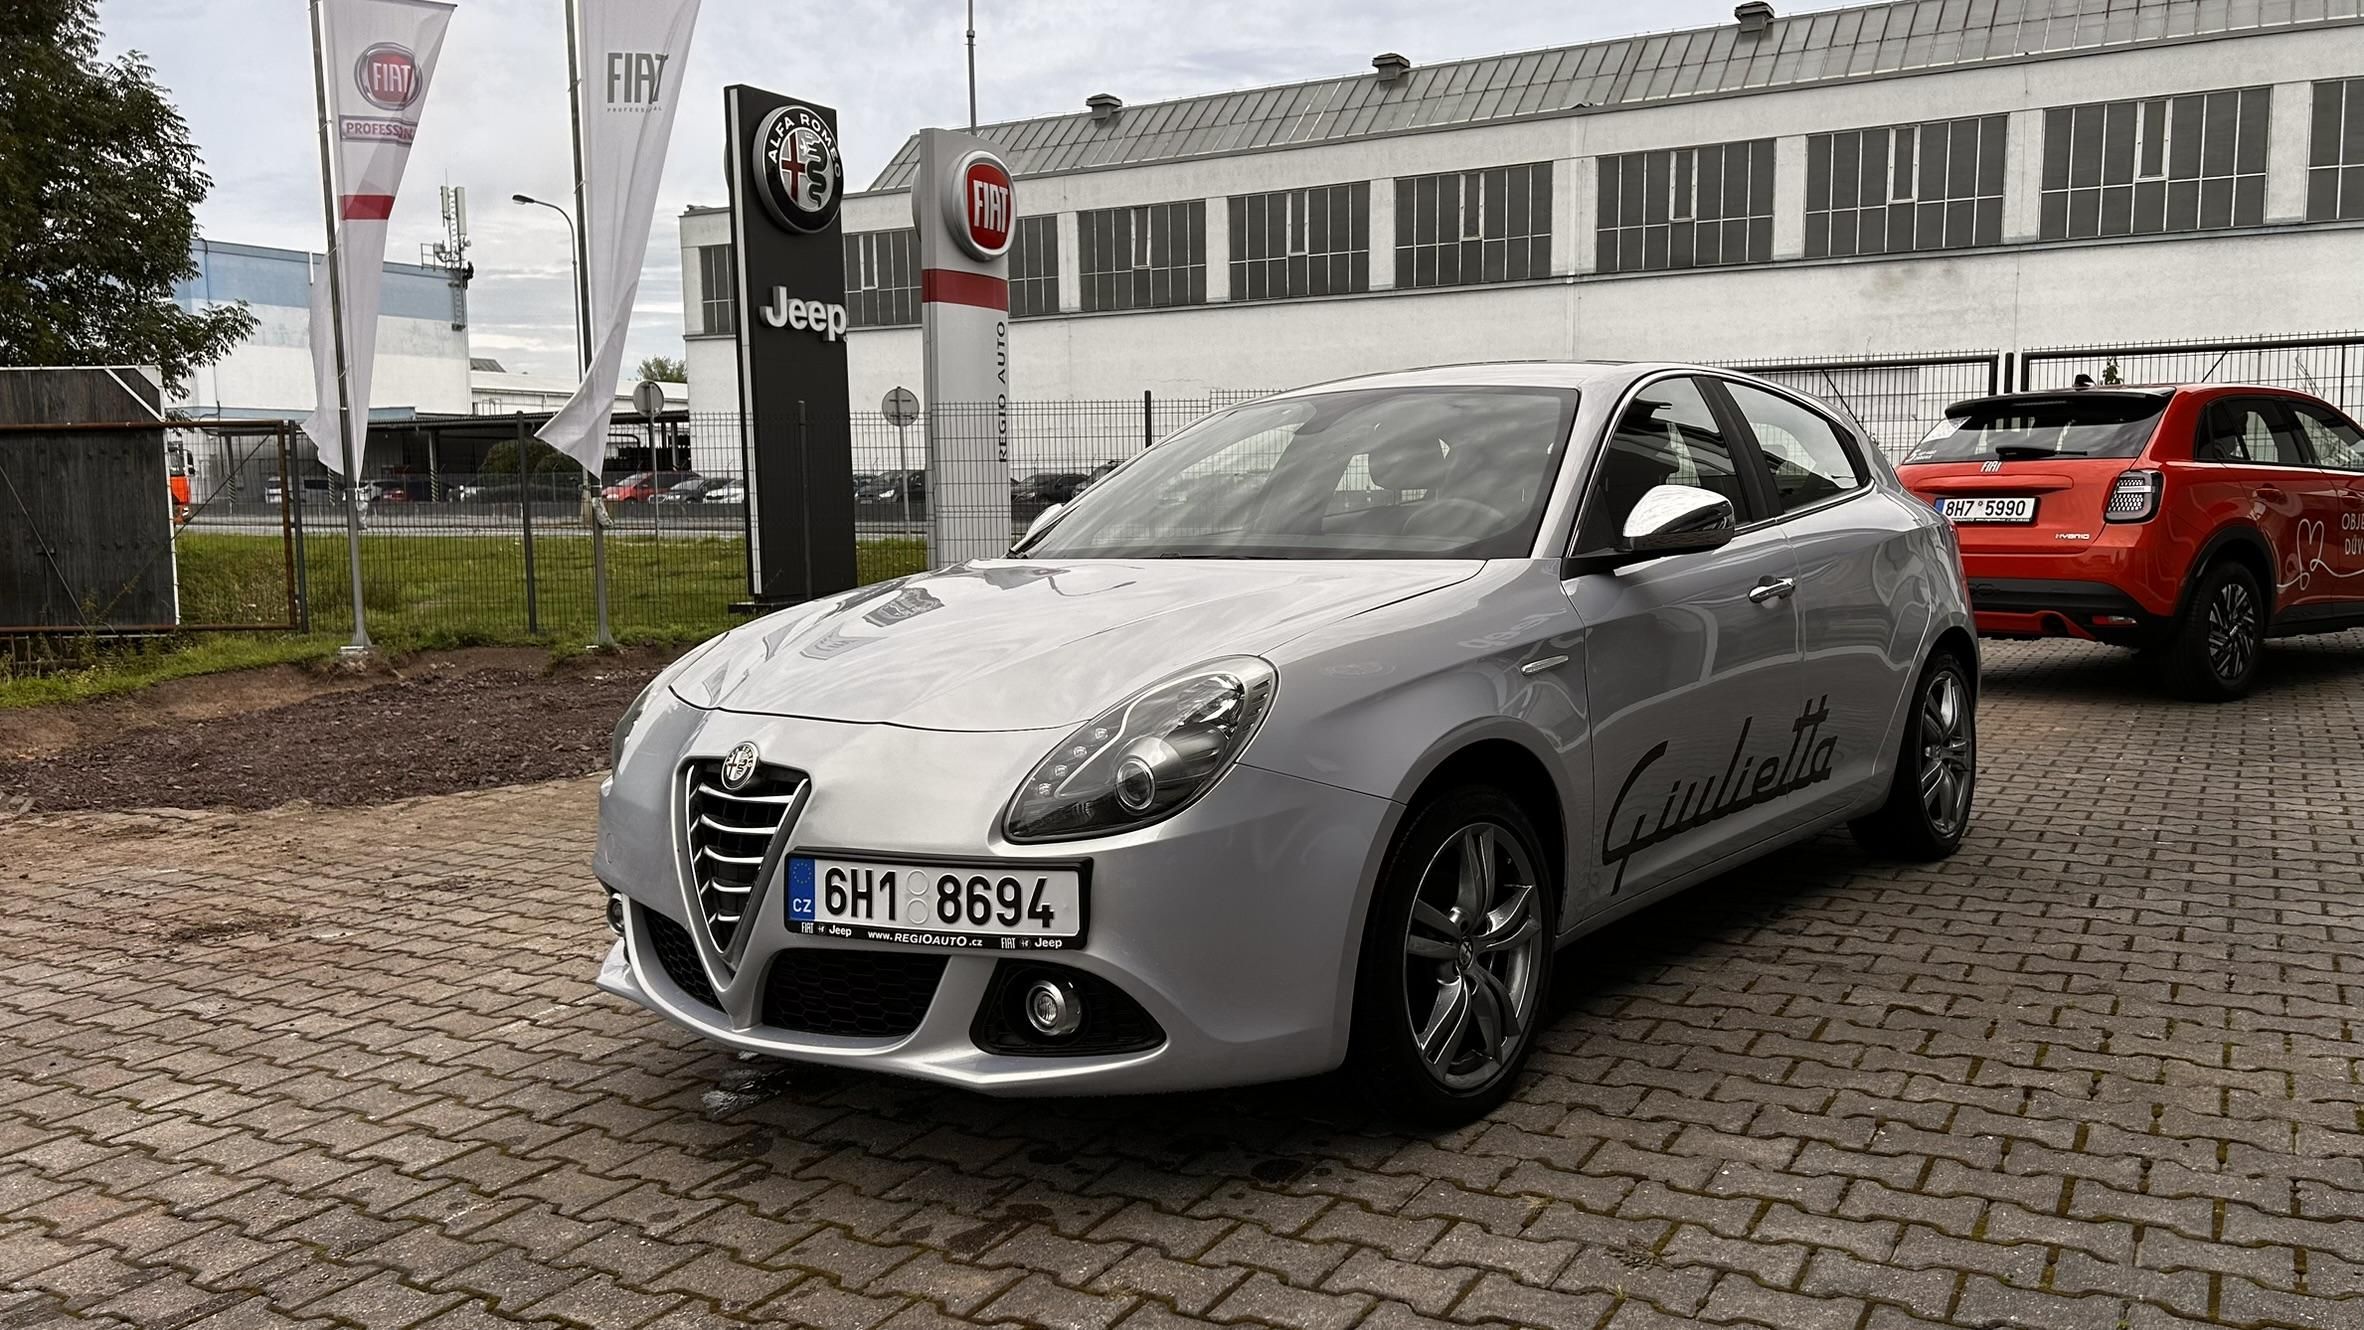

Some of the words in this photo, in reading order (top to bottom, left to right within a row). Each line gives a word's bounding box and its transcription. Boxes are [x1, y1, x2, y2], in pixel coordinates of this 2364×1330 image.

[373, 62, 411, 93] FIAT
[607, 53, 669, 104] FIAT
[768, 116, 795, 164] ALFA
[800, 113, 841, 178] ROMEO
[973, 180, 1008, 233] FIAT
[762, 286, 847, 341] Jeep
[997, 321, 1006, 385] AUTO
[998, 393, 1007, 462] REGIO
[1980, 460, 2002, 473] FIAT
[1945, 500, 1975, 517] 8H7
[1984, 500, 2026, 516] 5990
[2344, 534, 2364, 555] DŮV
[1602, 694, 1838, 896] Giulietta
[793, 898, 812, 913] CZ
[825, 867, 896, 921] 6H1
[936, 874, 1055, 929] 8694
[801, 922, 814, 934] FIAT
[828, 925, 852, 937] Jeep
[1001, 937, 1016, 949] FIAT
[1034, 937, 1063, 949] Jeep
